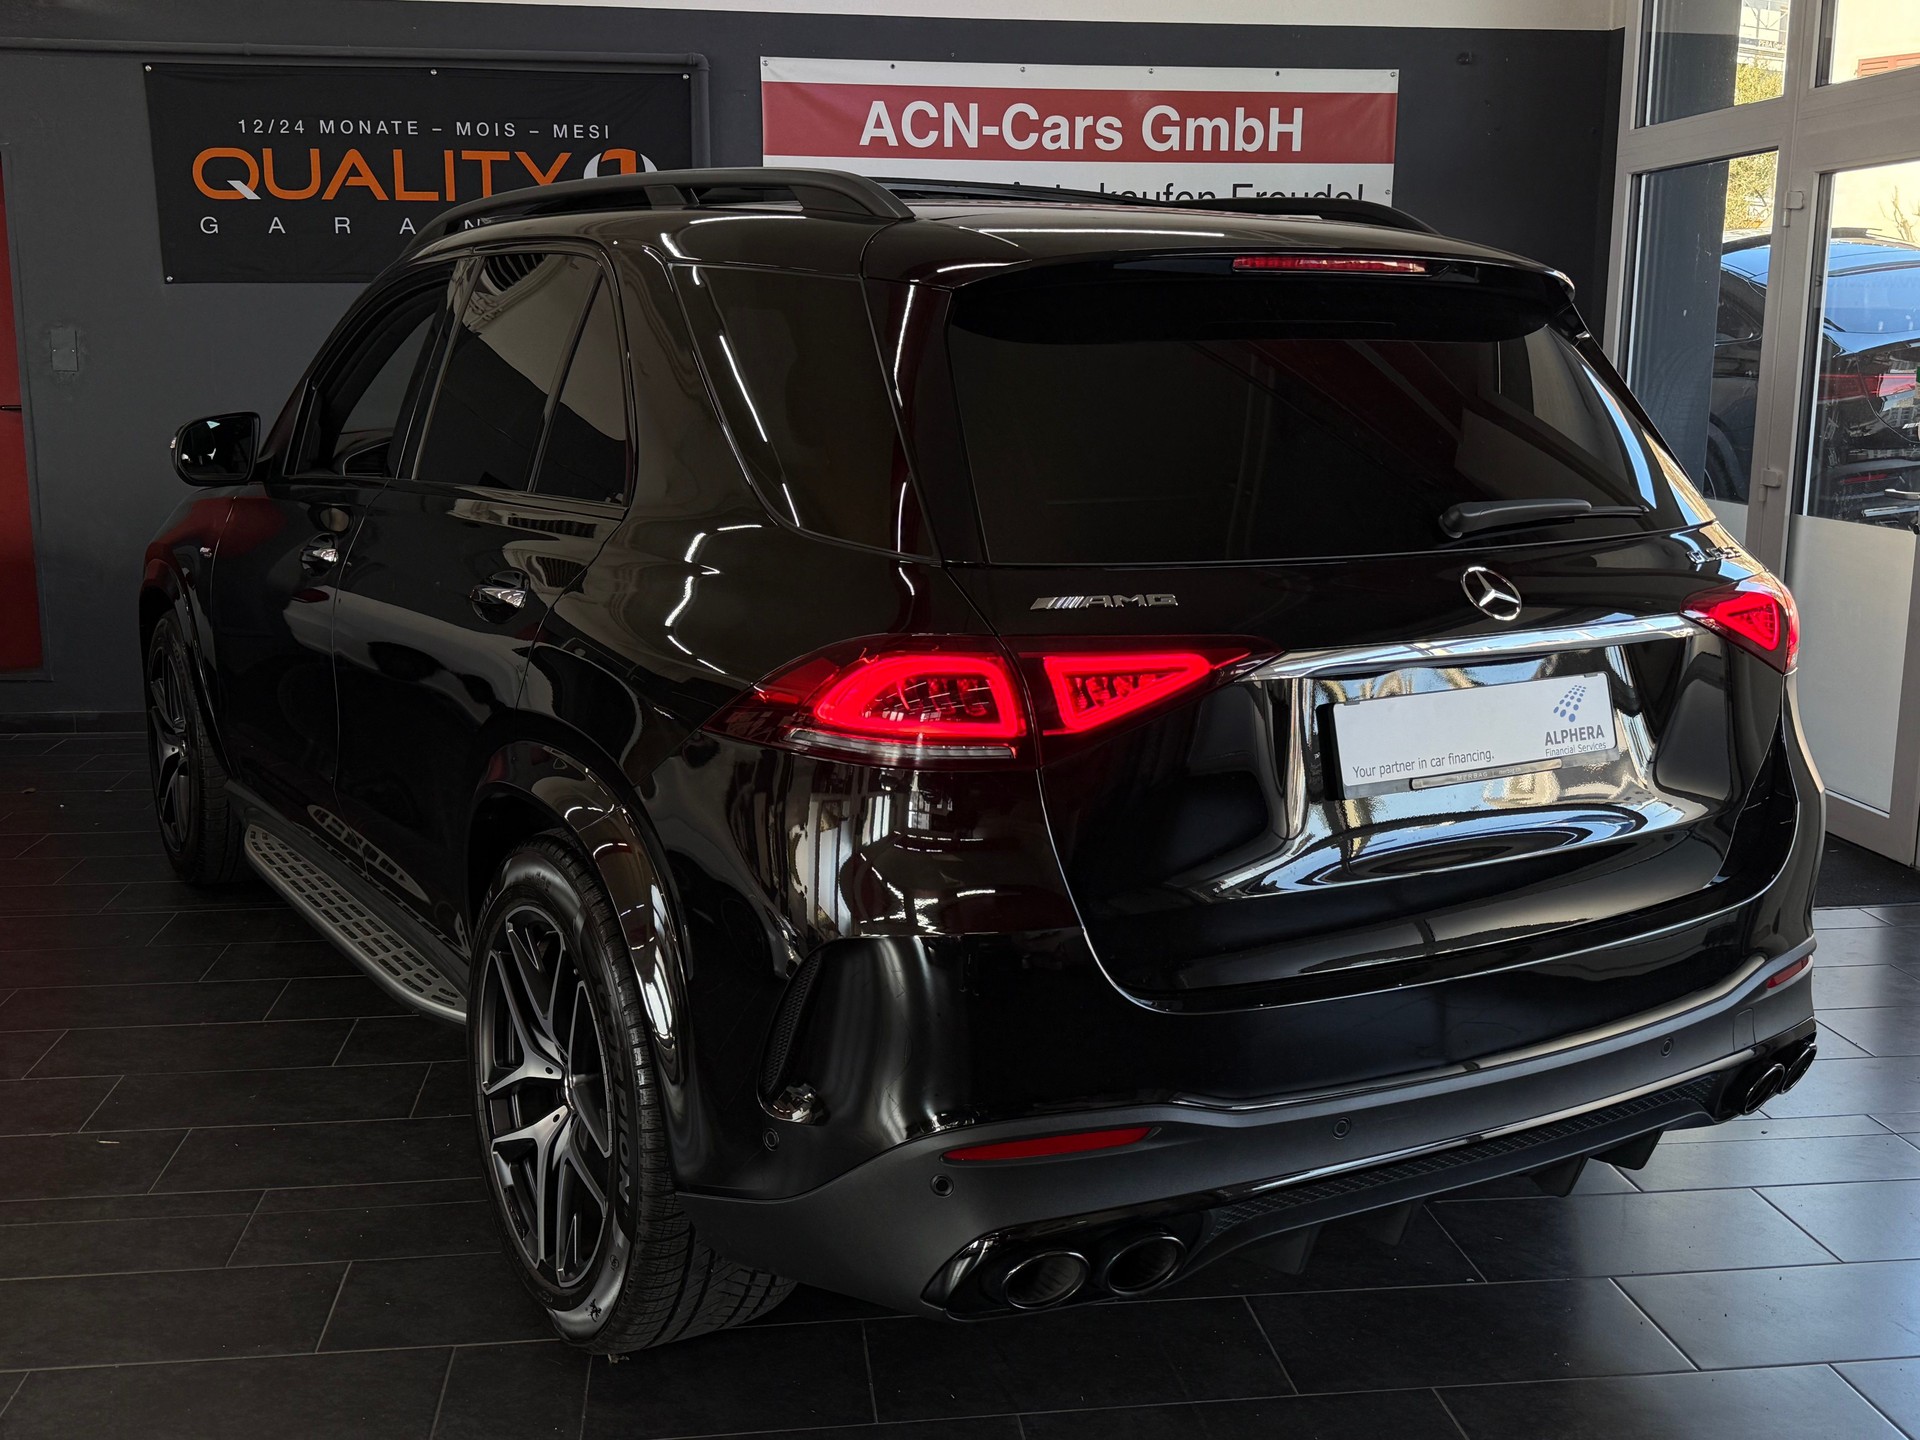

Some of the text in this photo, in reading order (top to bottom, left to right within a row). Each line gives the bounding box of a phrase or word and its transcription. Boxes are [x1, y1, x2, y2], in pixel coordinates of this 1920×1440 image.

[238, 119, 305, 134] 12/24
[319, 120, 419, 135] MONATE
[456, 121, 516, 137] MOIS
[553, 124, 609, 139] MESI
[859, 100, 1303, 152] ACN-Cars GmbH
[192, 147, 572, 201] QUALITY
[1079, 593, 1179, 608] AMG
[1544, 724, 1605, 746] ALPHERA
[1545, 741, 1607, 758] Financial Services
[1353, 749, 1495, 778] Your partner in car financing.
[1456, 771, 1488, 782] MERBAG
